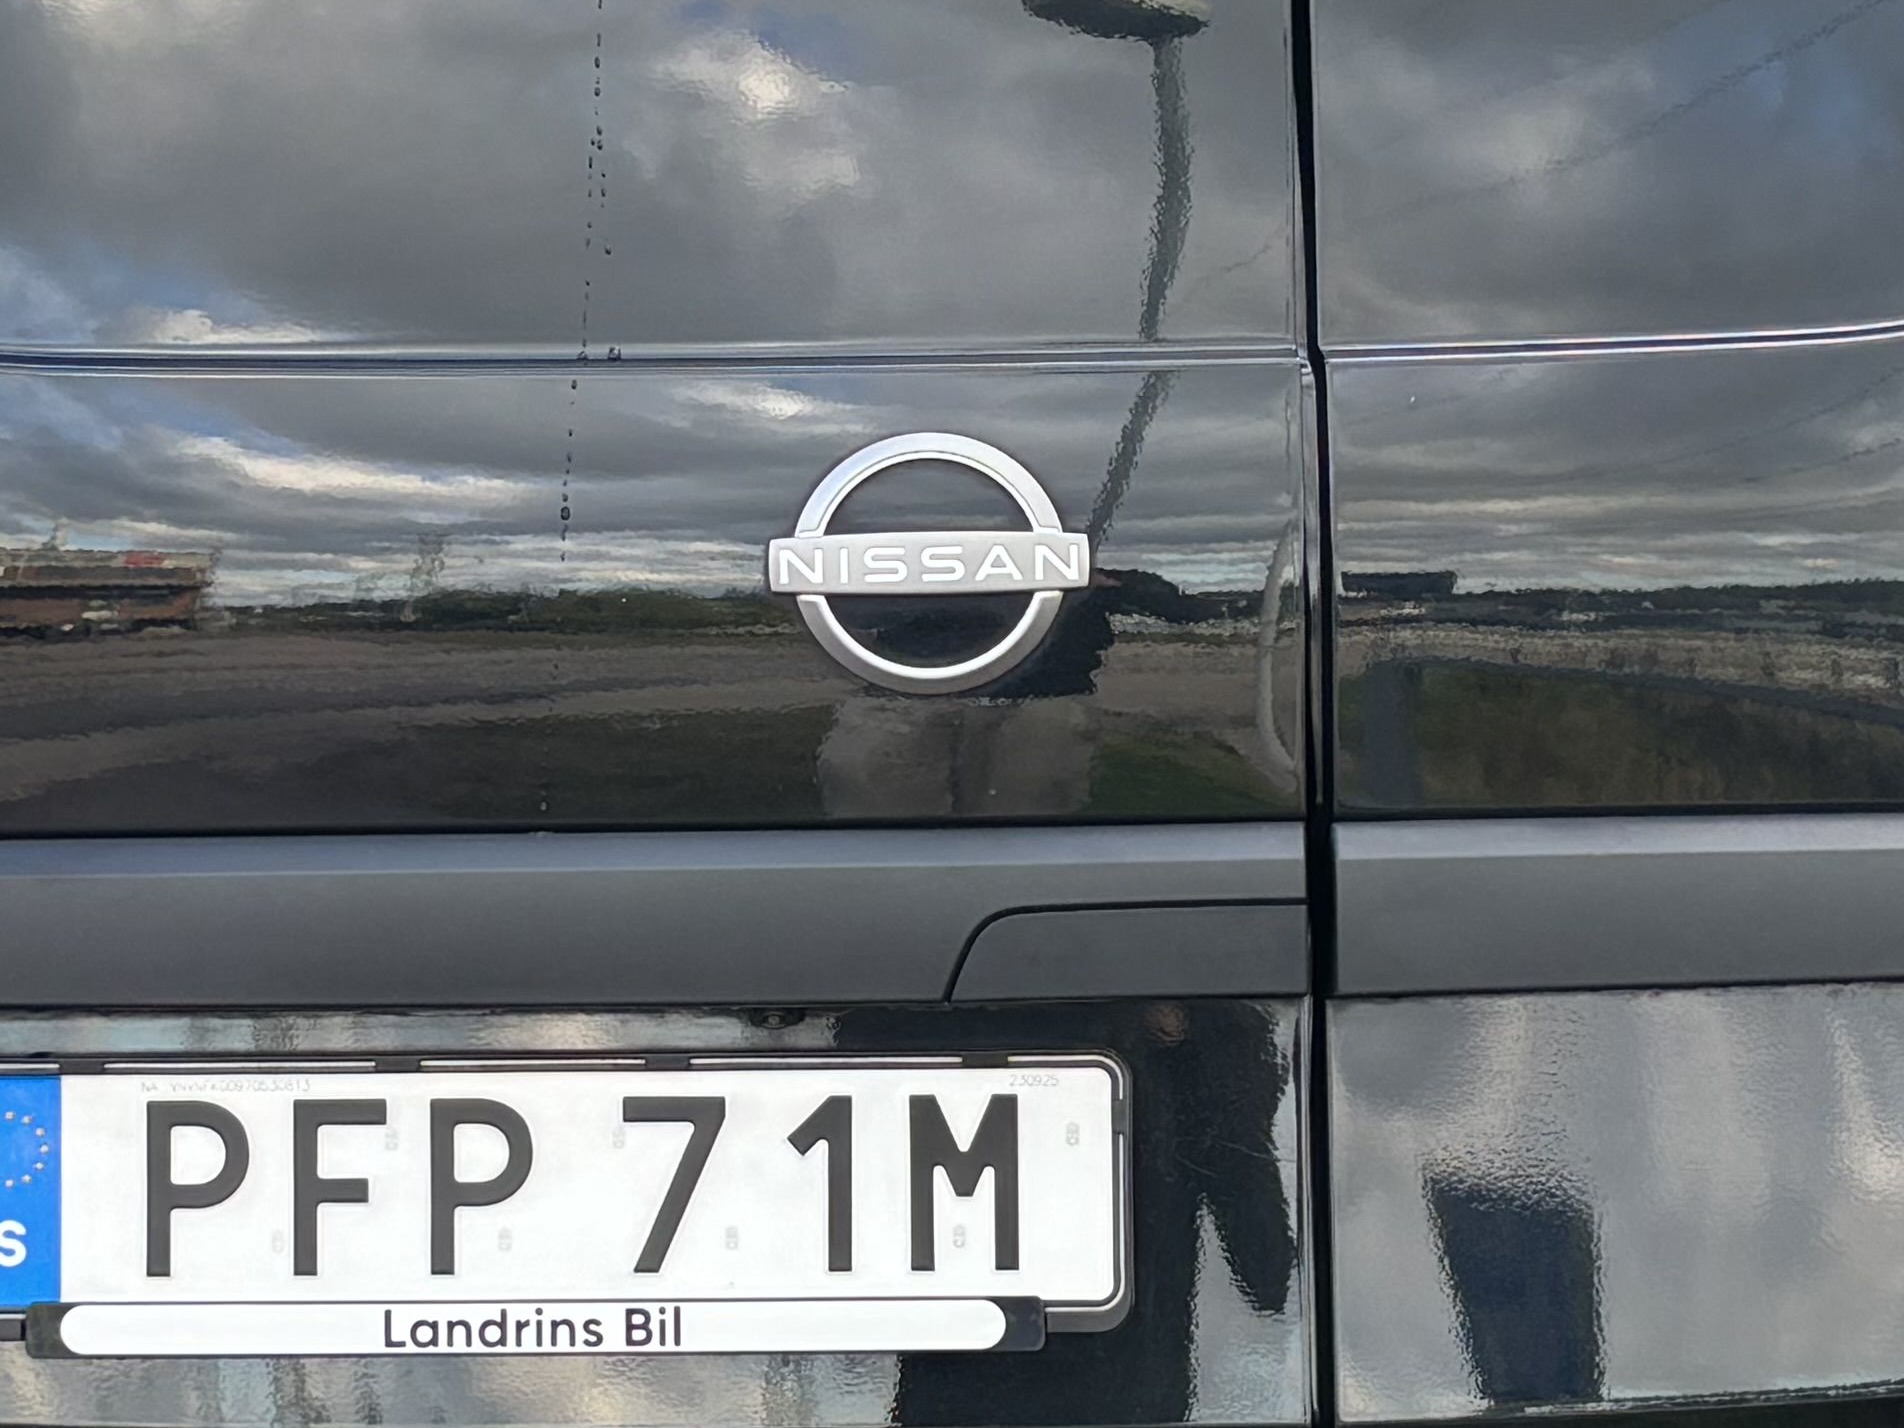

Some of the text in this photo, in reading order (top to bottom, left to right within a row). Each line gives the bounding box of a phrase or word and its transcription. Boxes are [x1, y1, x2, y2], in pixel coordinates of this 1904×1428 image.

[778, 543, 1081, 585] NISSAN
[146, 1092, 1021, 1278] PFP 71M
[383, 1305, 682, 1348] Landrins Bil
